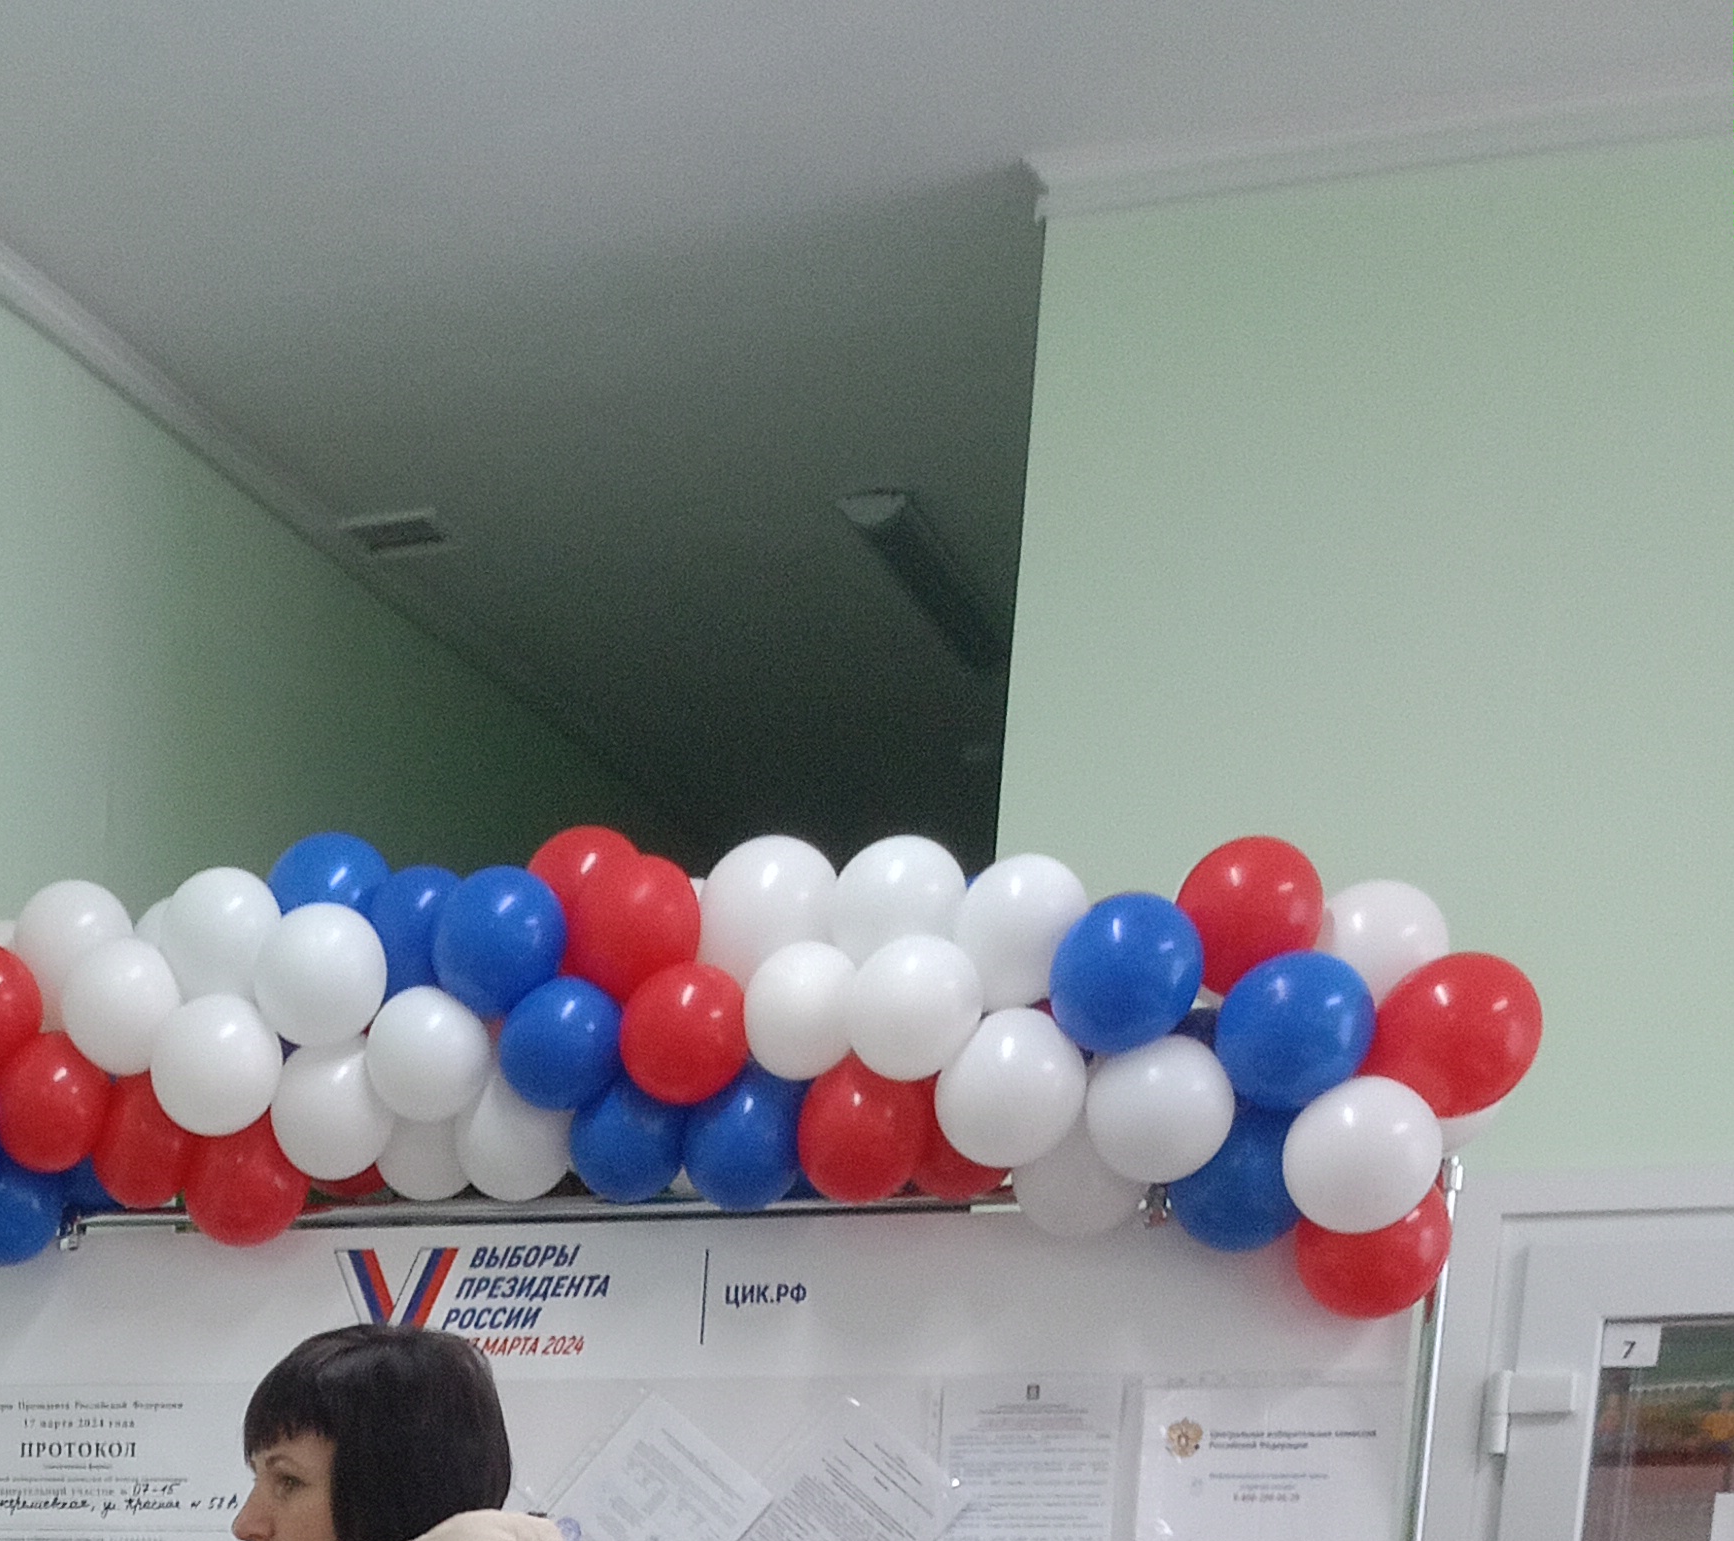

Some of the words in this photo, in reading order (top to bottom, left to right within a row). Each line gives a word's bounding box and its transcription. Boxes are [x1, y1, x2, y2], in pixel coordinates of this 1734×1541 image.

[469, 1243, 582, 1270] ВЫБОРЫ
[455, 1274, 611, 1302] ПРЕЗИДЕНТА
[725, 1282, 808, 1309] ЦИК.РФ
[441, 1306, 543, 1331] РОССИИ
[480, 1336, 541, 1356] МАРТА
[541, 1335, 585, 1356] 2024
[1623, 1340, 1637, 1359] 7
[19, 1441, 138, 1459] ПРОТОКОЛ
